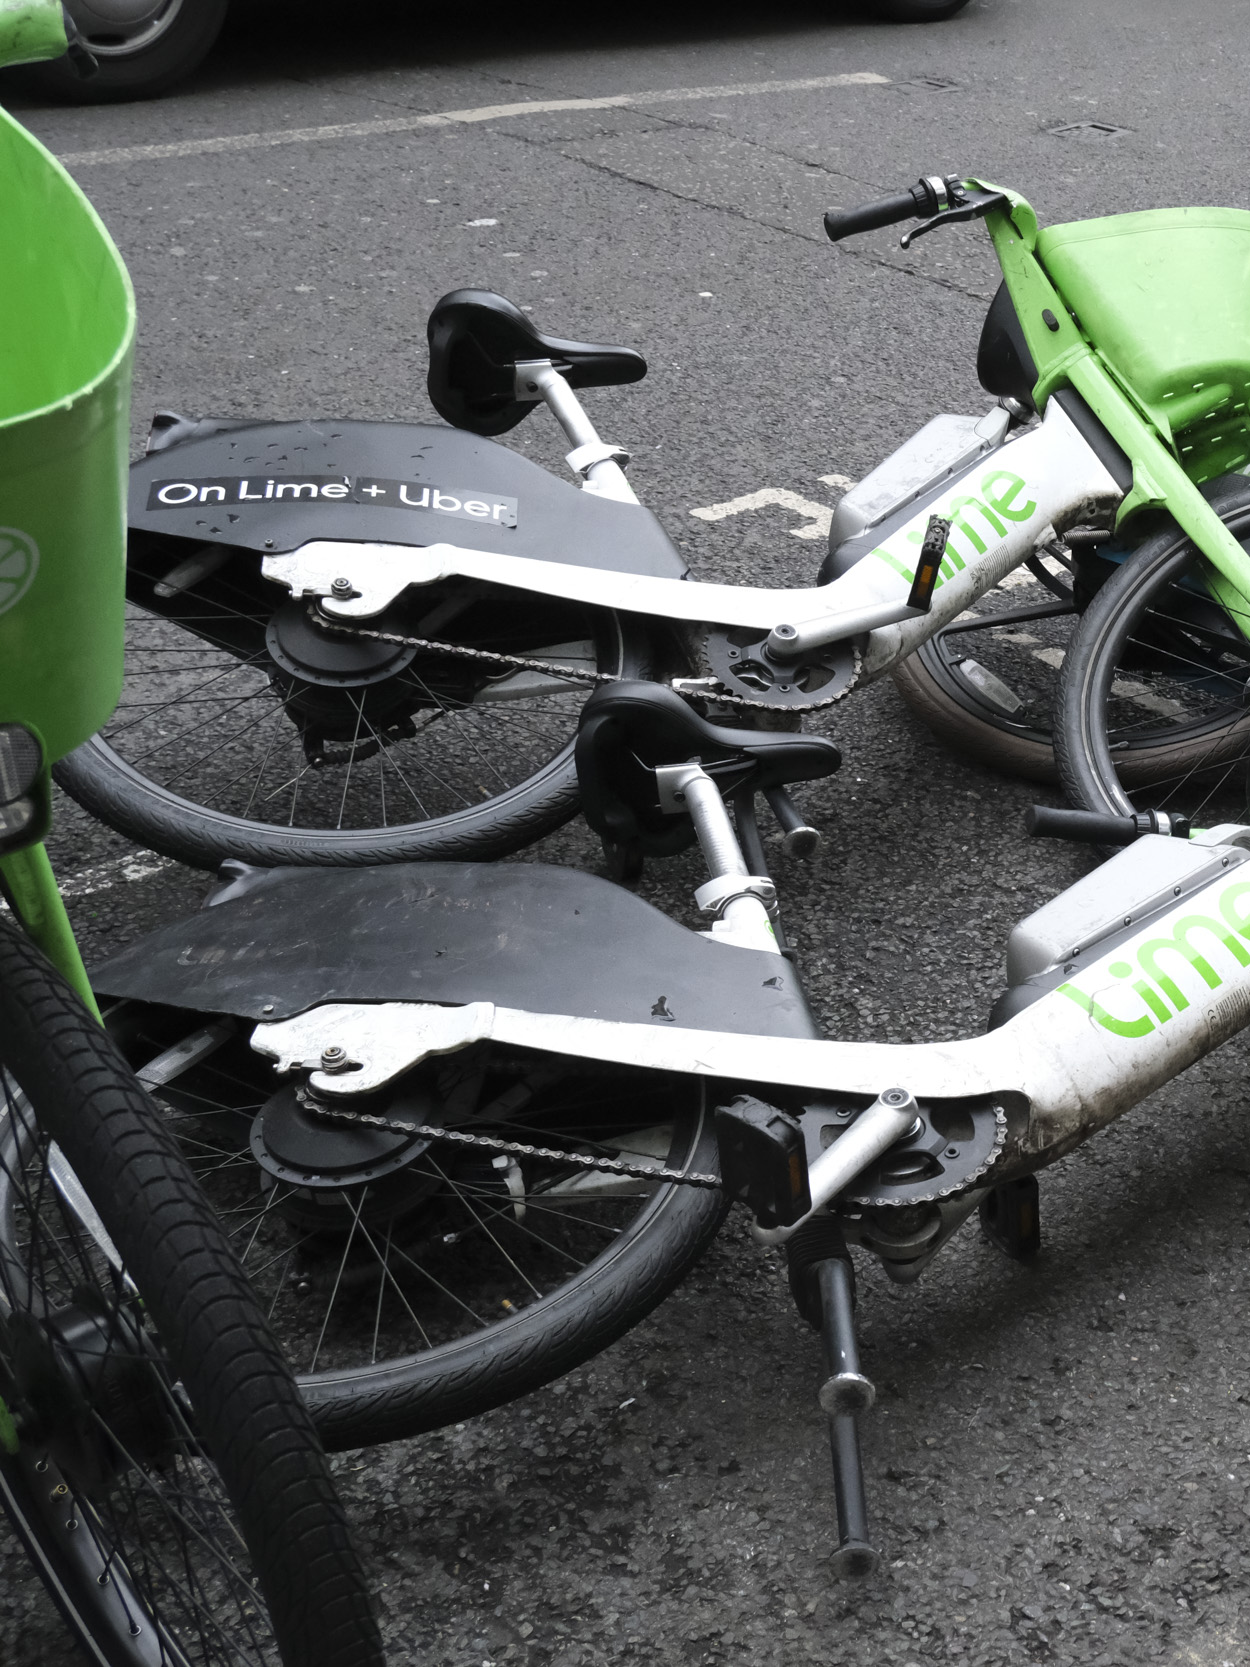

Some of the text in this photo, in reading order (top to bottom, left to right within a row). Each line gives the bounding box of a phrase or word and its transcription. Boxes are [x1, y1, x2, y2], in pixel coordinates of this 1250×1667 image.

[157, 479, 508, 520] On Lime + Uber
[870, 470, 1037, 590] Lime
